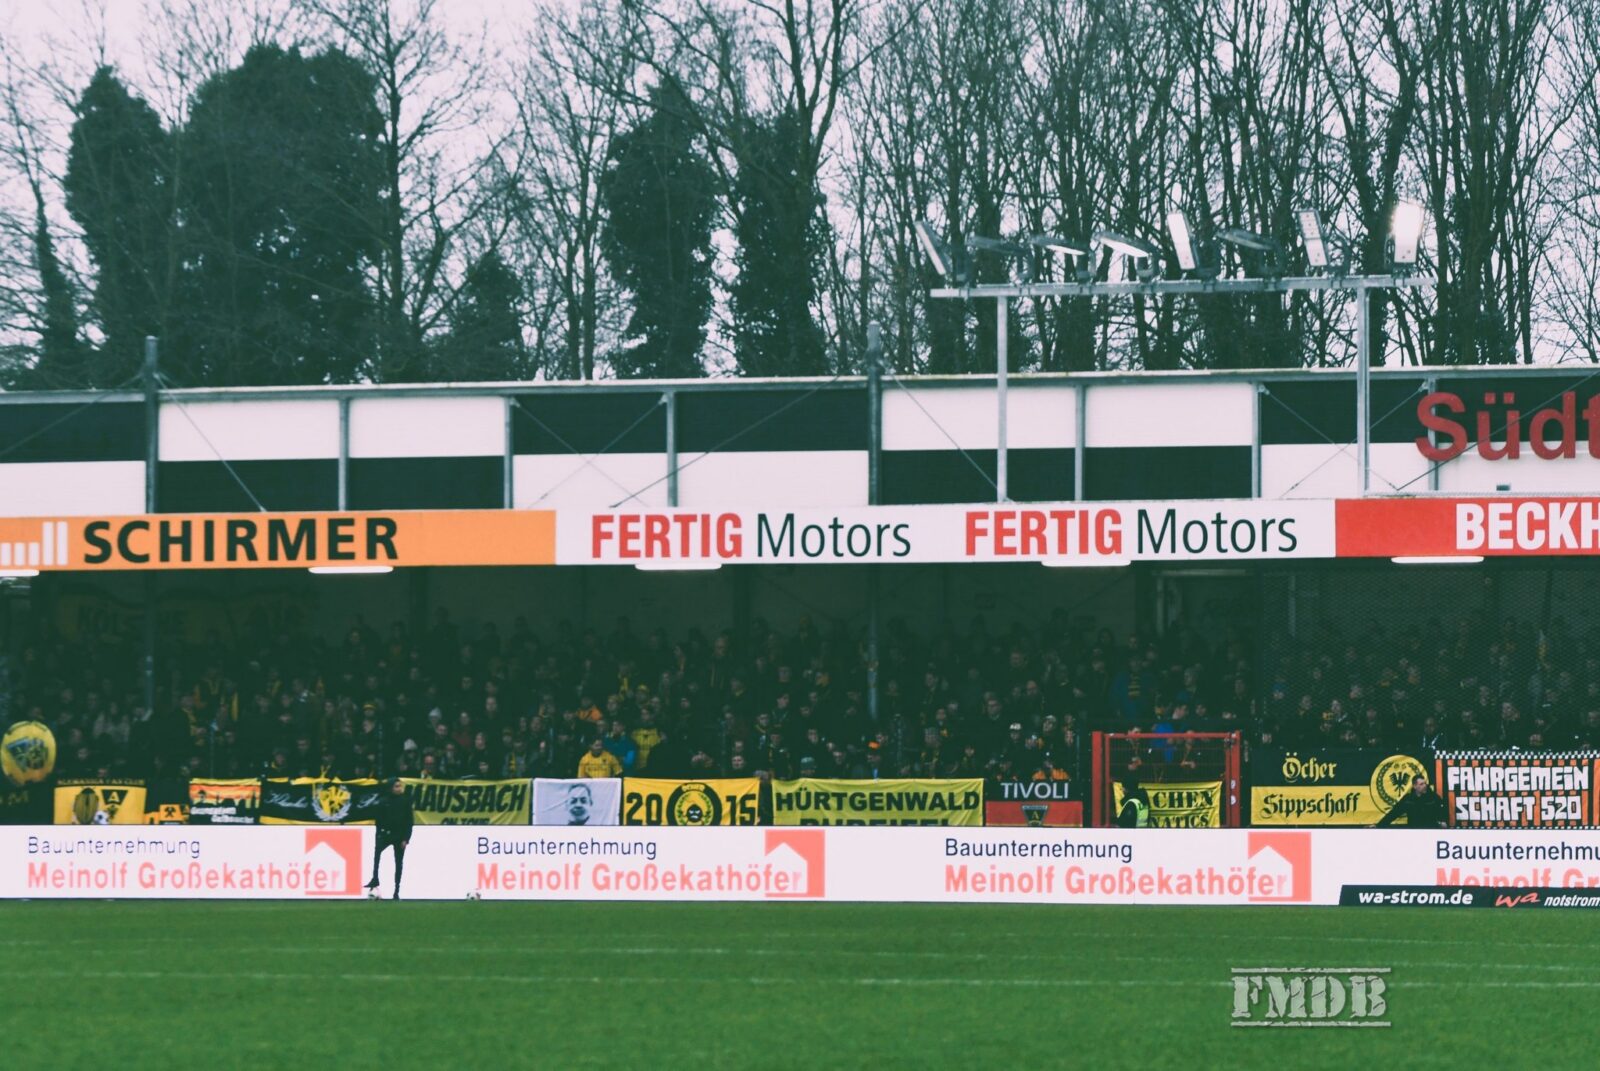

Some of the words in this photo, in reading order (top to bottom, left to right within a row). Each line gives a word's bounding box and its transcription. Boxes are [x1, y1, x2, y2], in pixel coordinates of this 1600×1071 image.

[83, 517, 399, 565] SCHIRMER
[592, 513, 743, 559] FERTIG
[757, 513, 912, 558] Motors
[966, 509, 1122, 556] FERTIG
[1137, 508, 1297, 554] Motors
[776, 787, 980, 812] HÜRTGENWALD
[1000, 782, 1069, 799] TIVOLI
[626, 792, 663, 825] 20
[725, 793, 757, 825] 15
[1455, 796, 1536, 821] SCHAFT
[1541, 796, 1582, 821] 520
[28, 836, 200, 860] Bauunternehmung
[477, 836, 657, 861] Bauunternehmung
[945, 838, 1133, 863] Bauunternehmung
[27, 862, 128, 889] Meinolf
[138, 862, 339, 890] Großekathöfer
[477, 863, 582, 891] Meinolf
[591, 863, 801, 892] Großekathöfer
[945, 865, 1054, 894] Meinolf
[1064, 865, 1287, 896] Großekathöfer
[1359, 889, 1474, 904] wa-strom.de
